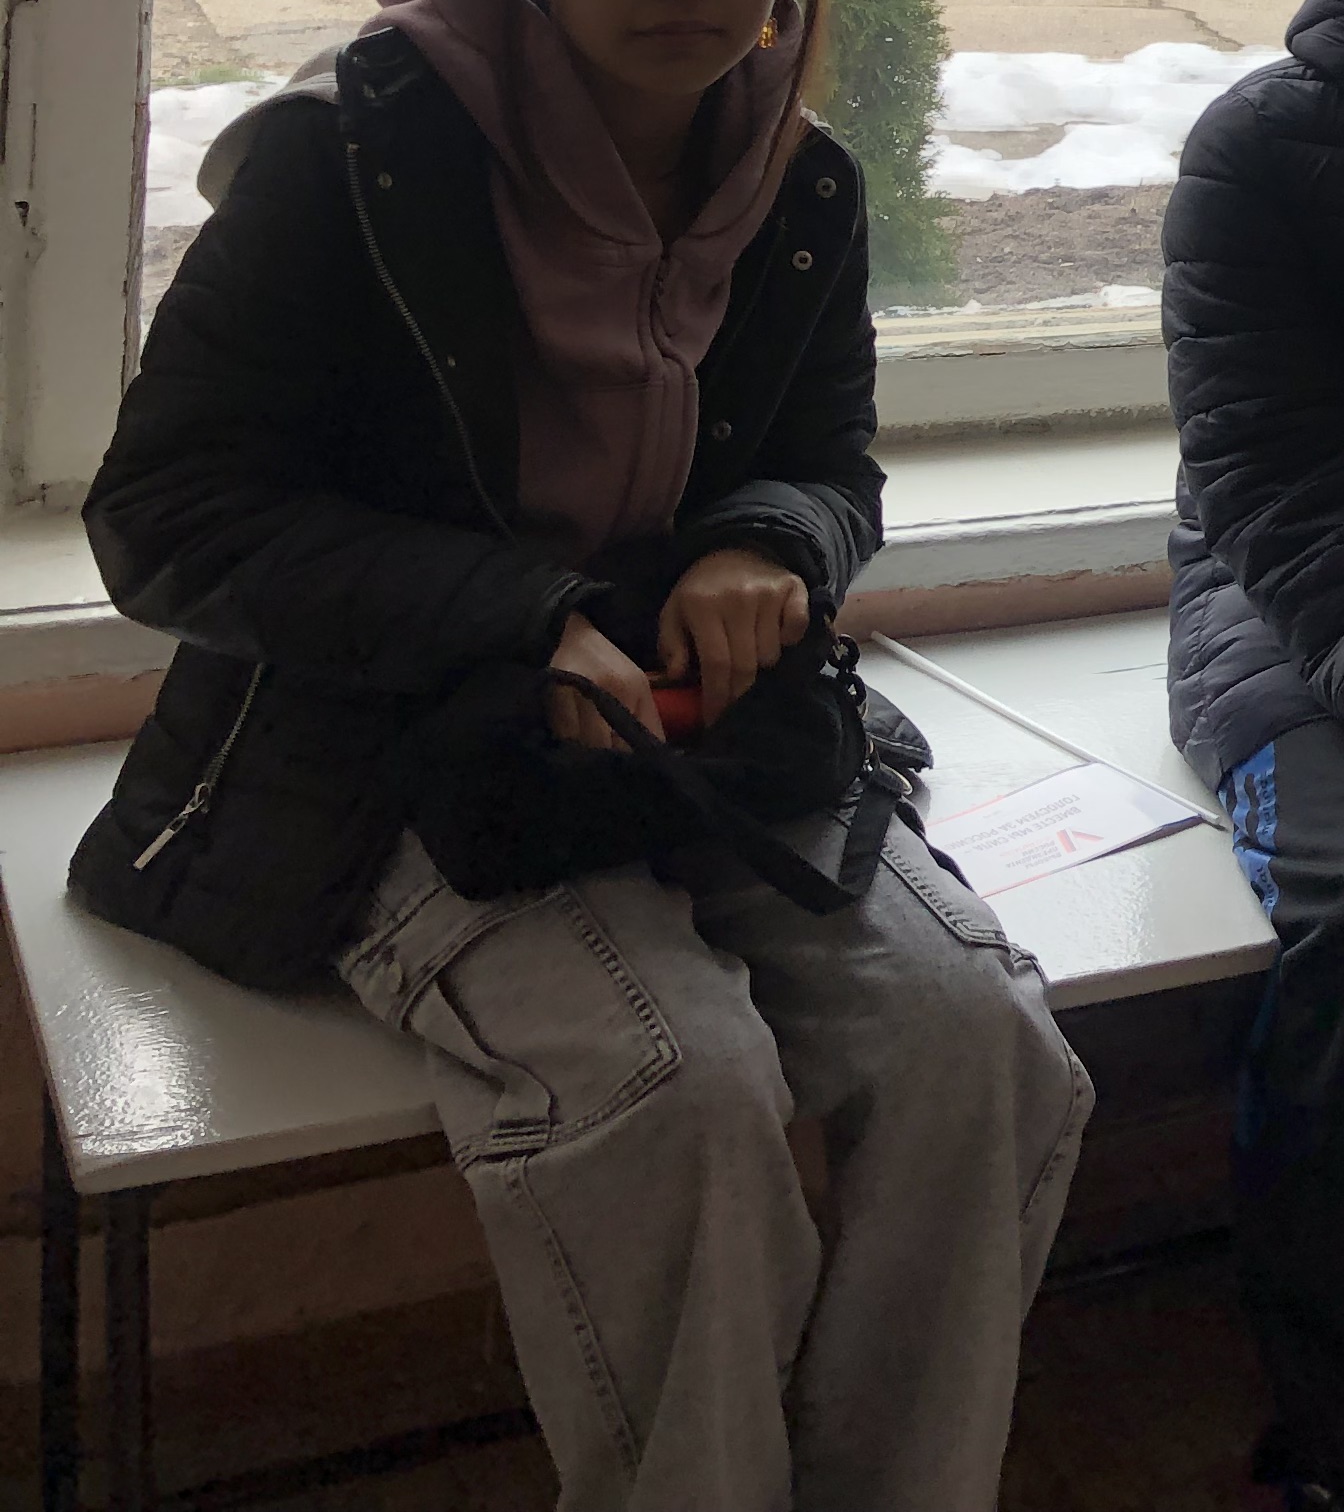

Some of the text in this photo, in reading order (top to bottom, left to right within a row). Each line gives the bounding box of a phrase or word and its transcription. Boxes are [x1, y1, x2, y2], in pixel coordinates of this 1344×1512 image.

[1010, 793, 1085, 825] ГОЛОСУЕМ
[970, 805, 1086, 853] ВМЕСТЕ МЫ СИЛА
[995, 821, 1017, 833] ЗА
